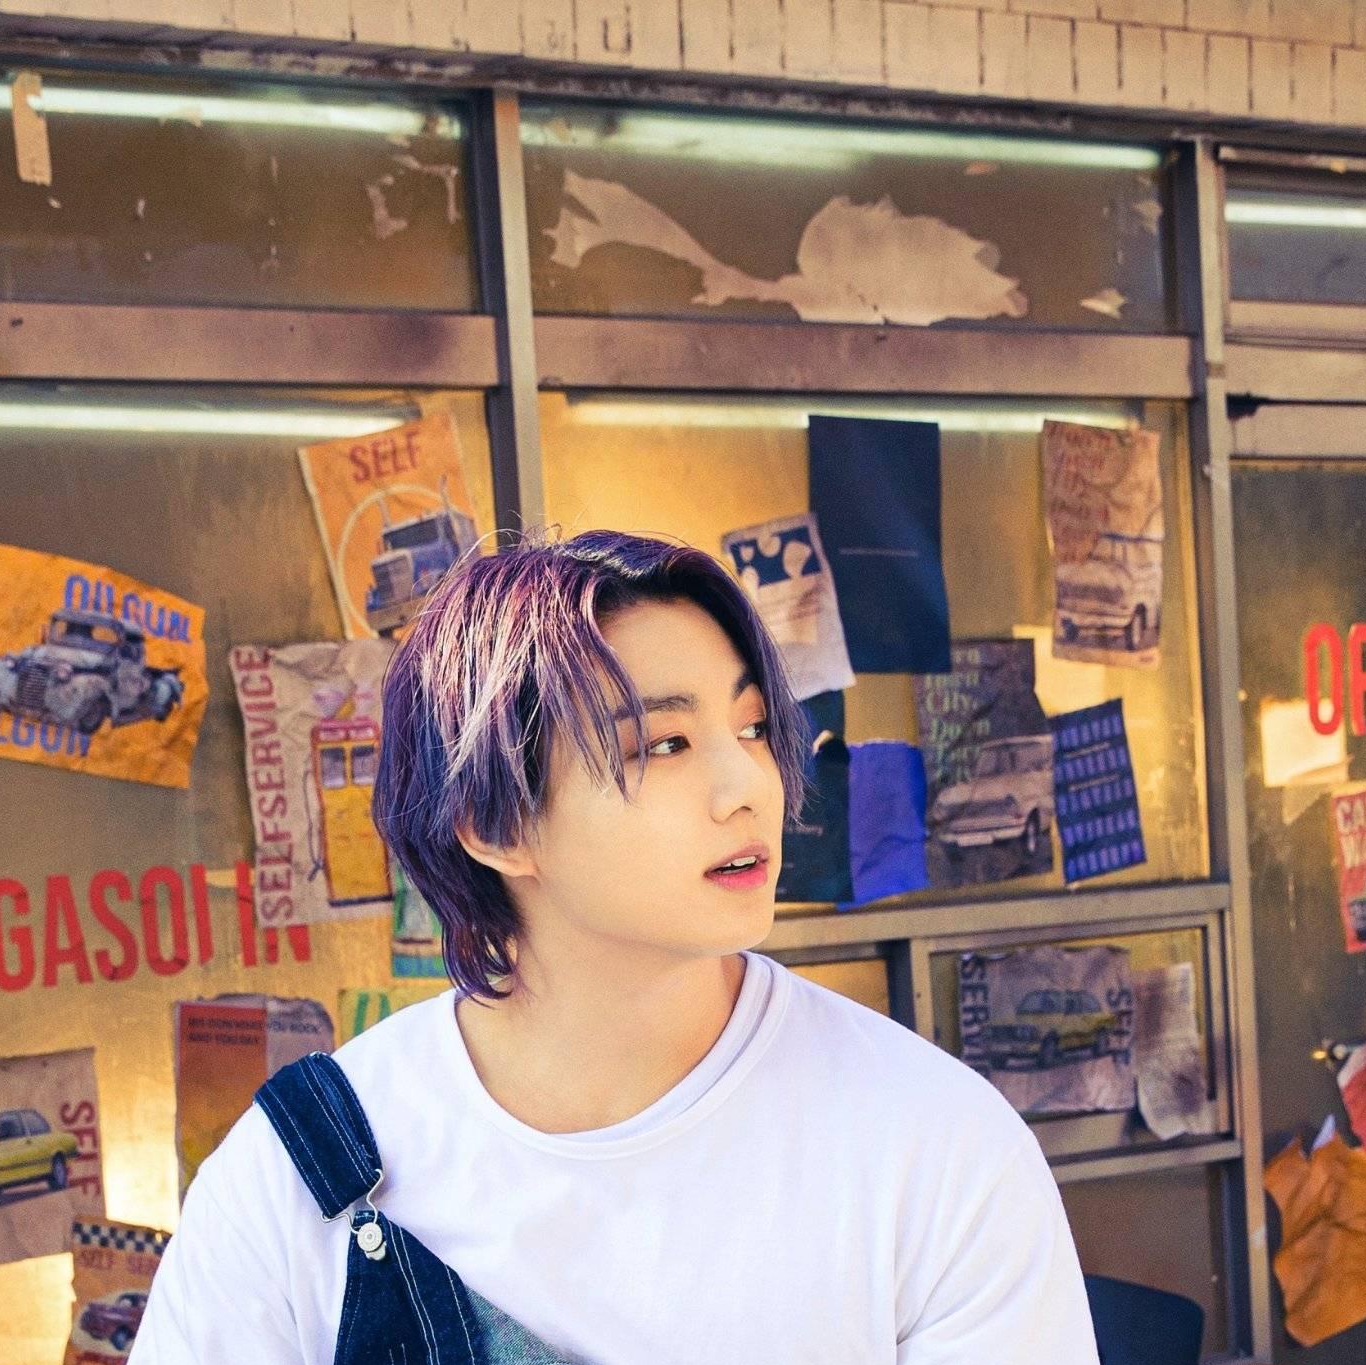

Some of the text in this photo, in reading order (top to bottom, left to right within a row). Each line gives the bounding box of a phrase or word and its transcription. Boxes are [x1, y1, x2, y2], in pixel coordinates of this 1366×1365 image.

[348, 431, 421, 484] SELF
[961, 957, 991, 1078] SERVI
[60, 1101, 101, 1198] SELF
